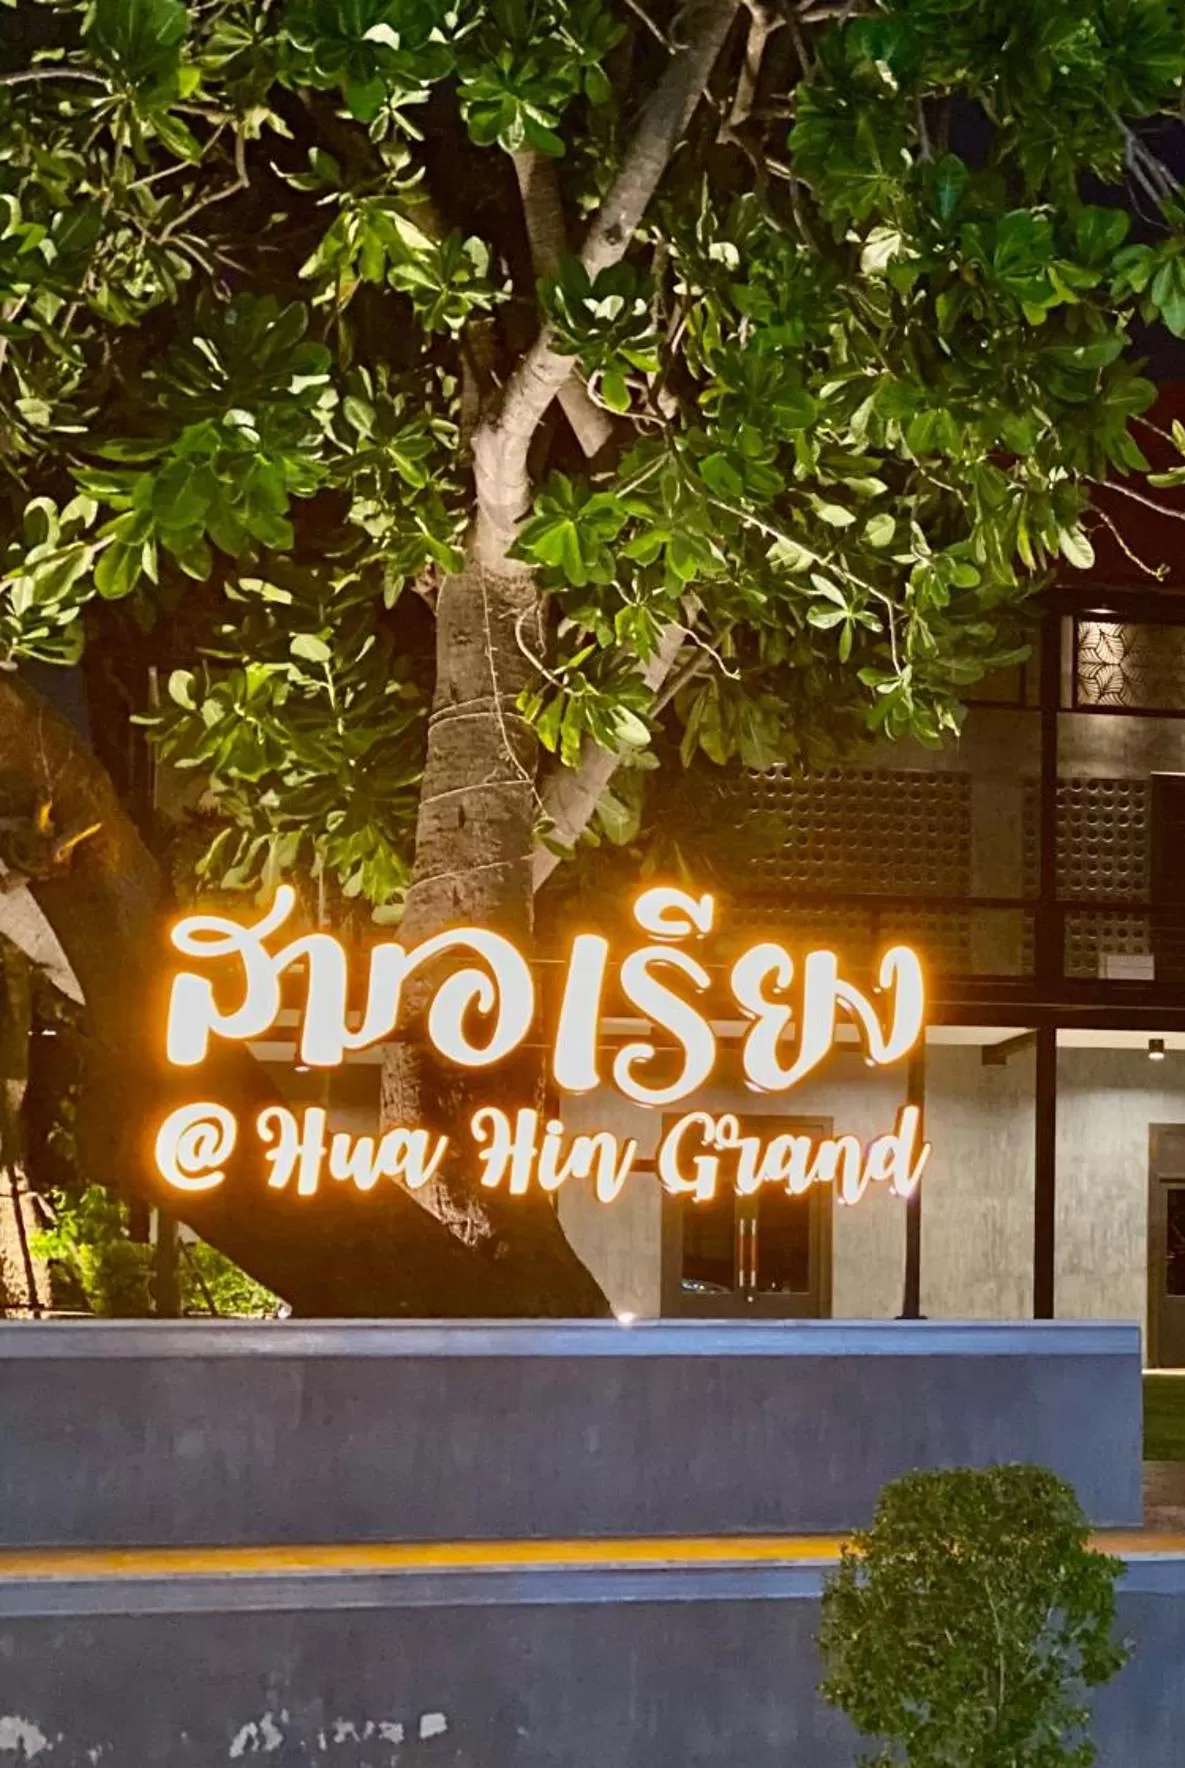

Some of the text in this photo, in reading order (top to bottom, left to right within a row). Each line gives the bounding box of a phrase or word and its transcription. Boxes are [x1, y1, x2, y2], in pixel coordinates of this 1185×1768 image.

[166, 884, 924, 1105] สมอเรียง
[155, 1102, 932, 1205] @ Hua Hin Grand
